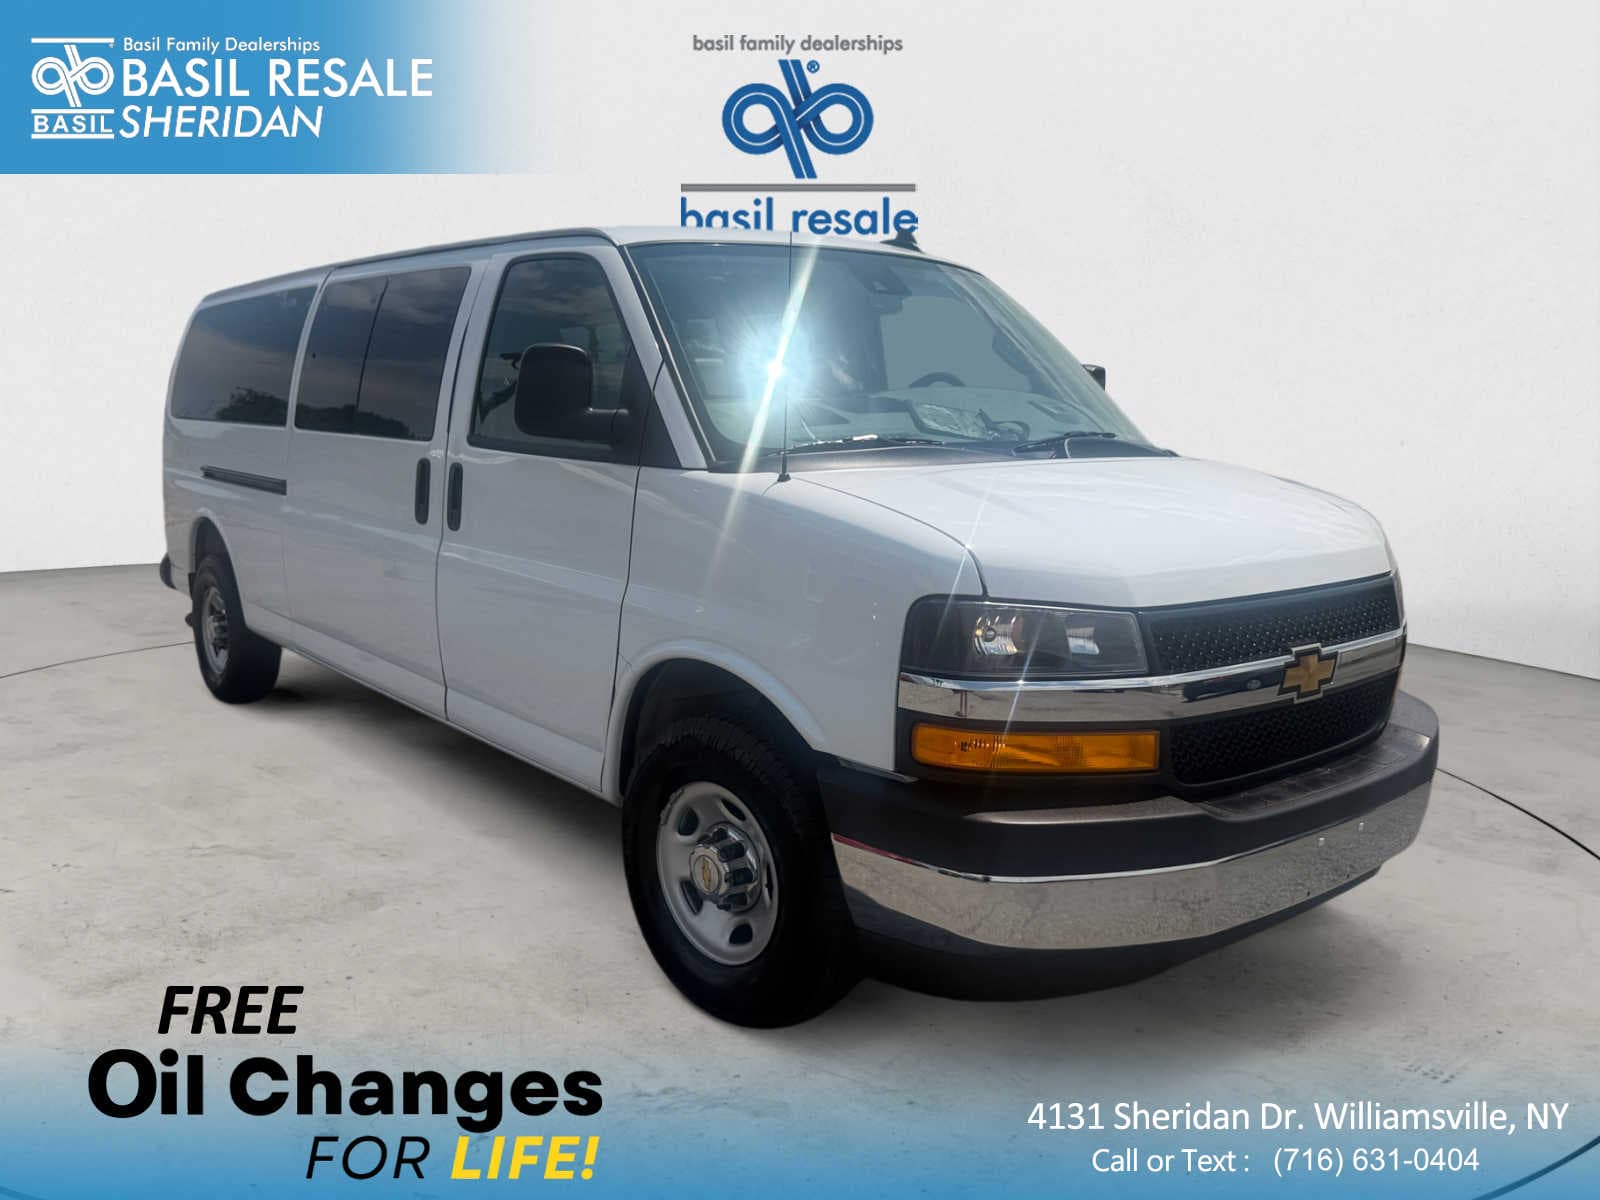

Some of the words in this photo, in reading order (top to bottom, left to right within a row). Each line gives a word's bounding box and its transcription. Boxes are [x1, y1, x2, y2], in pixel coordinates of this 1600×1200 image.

[693, 35, 734, 51] basil
[740, 35, 795, 55] family
[800, 35, 903, 55] dealerships
[681, 197, 774, 231] basil
[792, 197, 919, 235] resale
